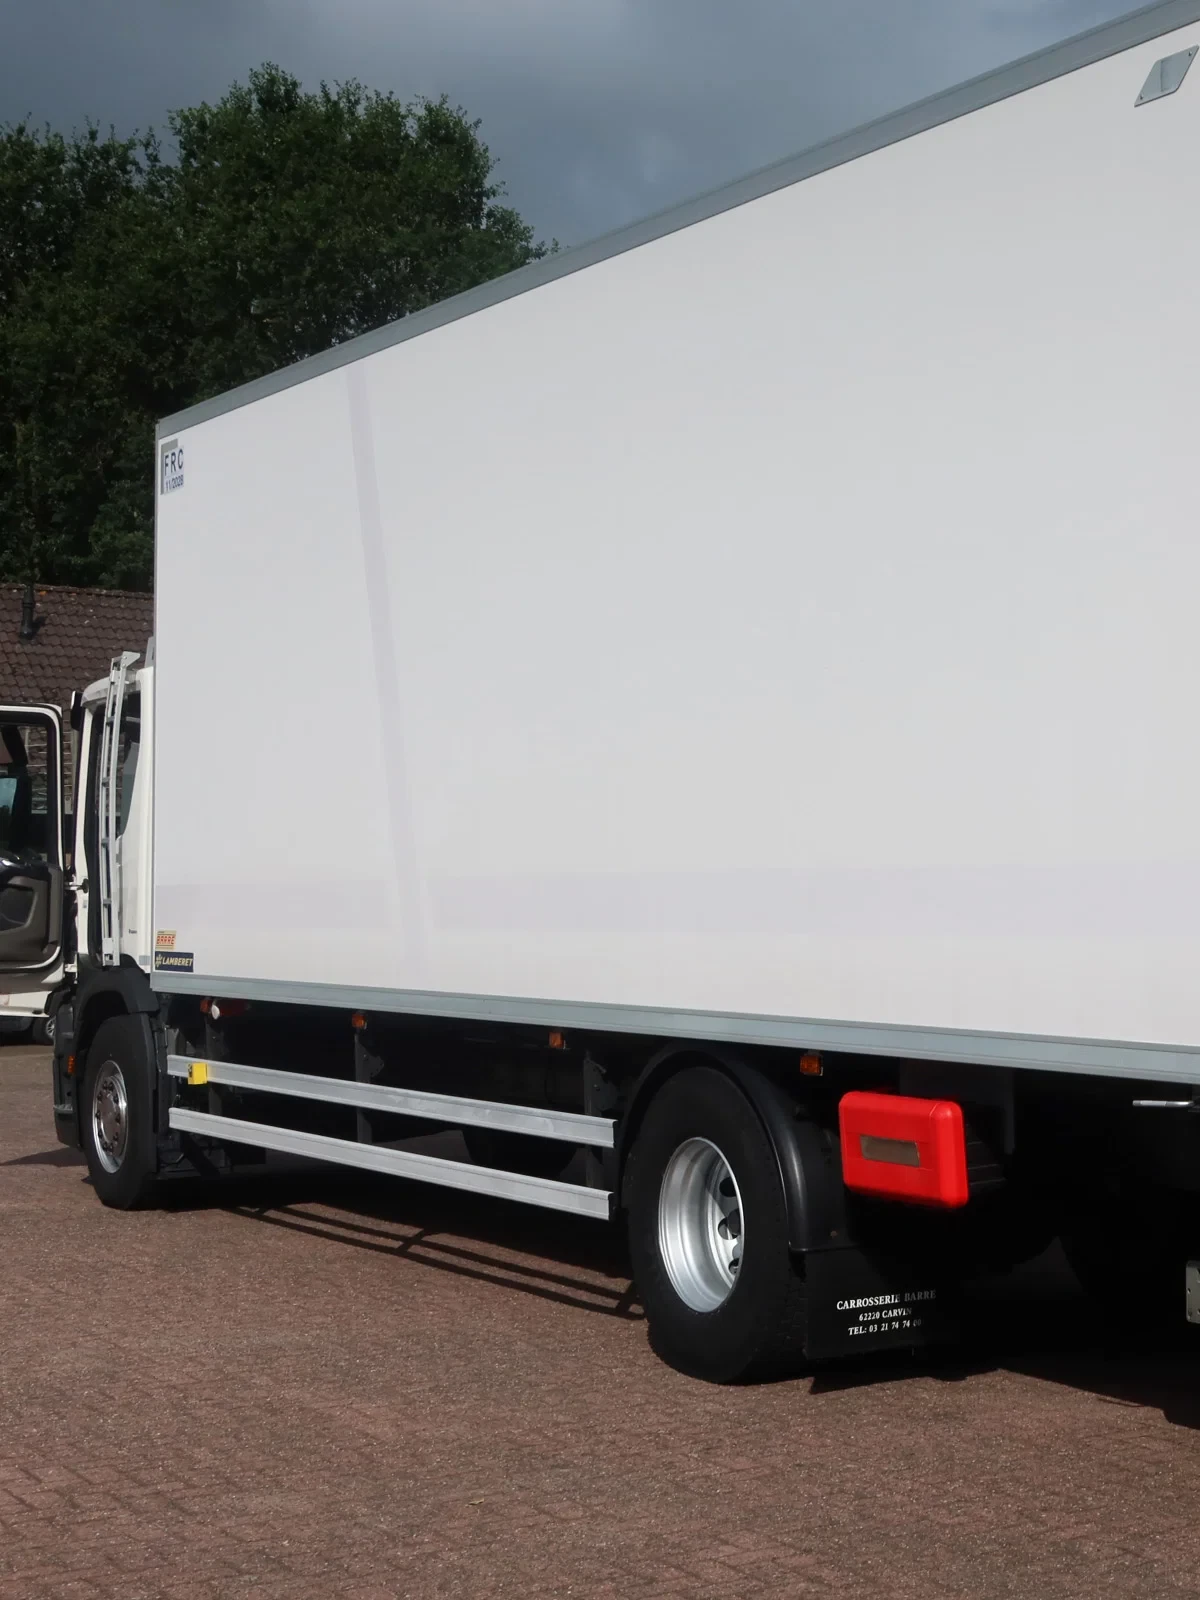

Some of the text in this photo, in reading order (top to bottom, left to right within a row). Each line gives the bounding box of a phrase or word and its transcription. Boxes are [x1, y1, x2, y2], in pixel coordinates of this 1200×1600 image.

[164, 448, 184, 476] FRC
[162, 956, 193, 967] LAMBERET
[836, 1294, 900, 1310] CARROSSERIE
[859, 1307, 912, 1322] 62220 CARVIN
[848, 1325, 867, 1336] TEL:
[869, 1324, 878, 1333] 03
[880, 1322, 889, 1332] 21
[891, 1321, 899, 1330] 74
[902, 1319, 911, 1329] 74
